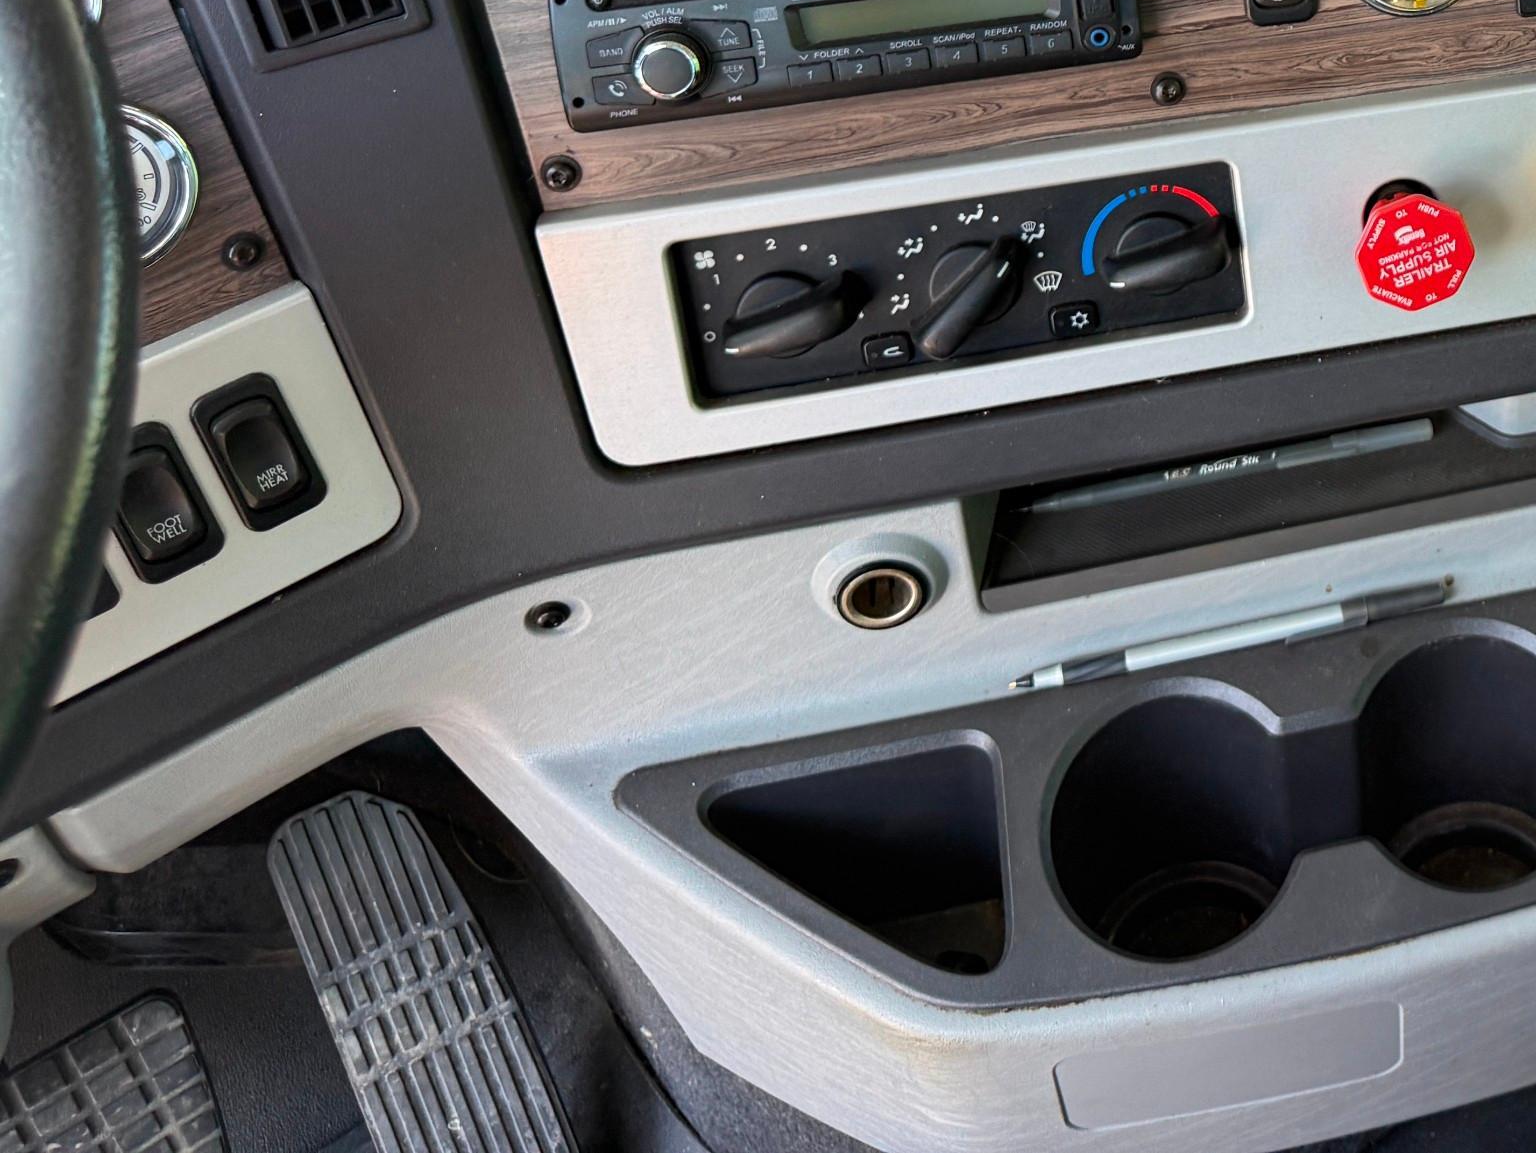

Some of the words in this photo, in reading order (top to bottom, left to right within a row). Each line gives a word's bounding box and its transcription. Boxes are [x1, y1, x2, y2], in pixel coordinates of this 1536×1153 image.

[642, 10, 660, 20] VOL
[665, 7, 685, 16] ALM
[1030, 19, 1068, 31] RANDOM
[717, 36, 742, 47] TUNE
[889, 38, 923, 49] SCROLL
[933, 32, 976, 44] SCAN/iPod
[599, 47, 624, 58] BAND
[813, 48, 850, 61] FOLDER
[722, 62, 745, 74] SEEK
[905, 57, 913, 67] 3
[610, 108, 638, 119] PHONE
[1395, 208, 1408, 219] TO
[1417, 202, 1440, 217] PUSH
[1367, 218, 1386, 250] SUPPLY
[1434, 232, 1450, 245] NOT
[765, 237, 777, 251] 2
[1434, 239, 1456, 257] AIR
[827, 253, 838, 266] 3
[1378, 249, 1415, 266] PARKING
[1380, 250, 1433, 281] SUPPLY
[1394, 258, 1452, 289] TRAILER
[1447, 269, 1463, 289] PULL
[1372, 284, 1413, 307] EVACUATE
[1425, 292, 1438, 302] TO
[256, 463, 285, 484] MIRR
[1200, 459, 1238, 476] Round
[260, 471, 290, 492] HEAT
[147, 514, 182, 537] FOOT
[151, 523, 188, 544] WELL
